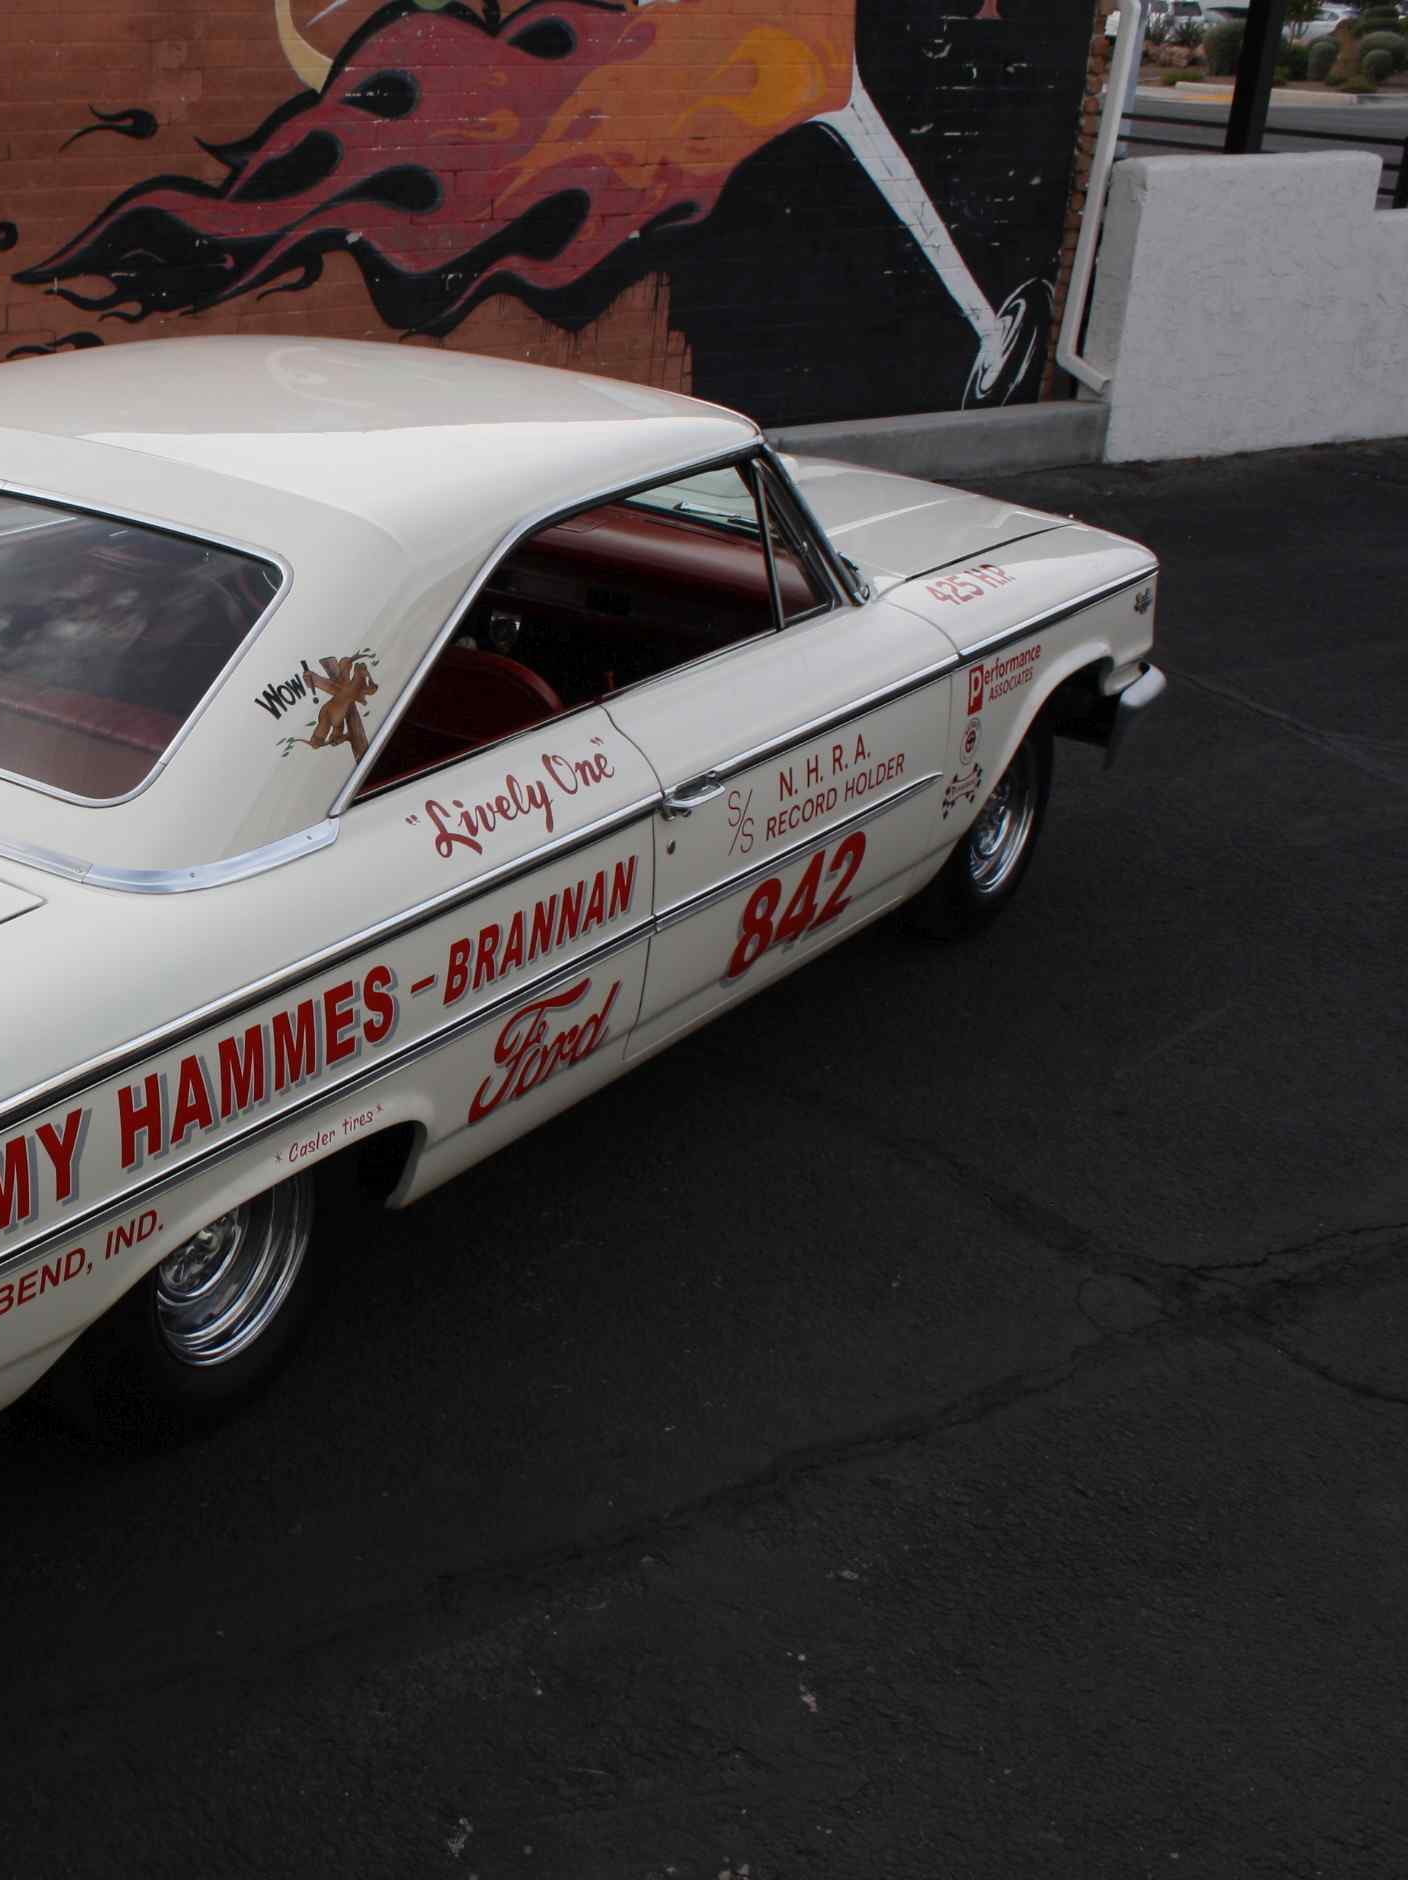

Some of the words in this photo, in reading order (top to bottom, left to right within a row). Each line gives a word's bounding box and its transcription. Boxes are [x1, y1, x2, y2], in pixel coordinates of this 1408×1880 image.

[926, 576, 984, 605] 425
[969, 645, 1041, 712] Performance
[988, 667, 1033, 702] ASSOCIATES
[766, 788, 837, 841] RECORD
[844, 753, 905, 802] HOLDER
[724, 831, 866, 982] 842
[117, 965, 397, 1170] HAMMES
[442, 855, 638, 1006] BRANNAN
[468, 977, 621, 1125] Ford
[105, 1209, 164, 1260] IND.
